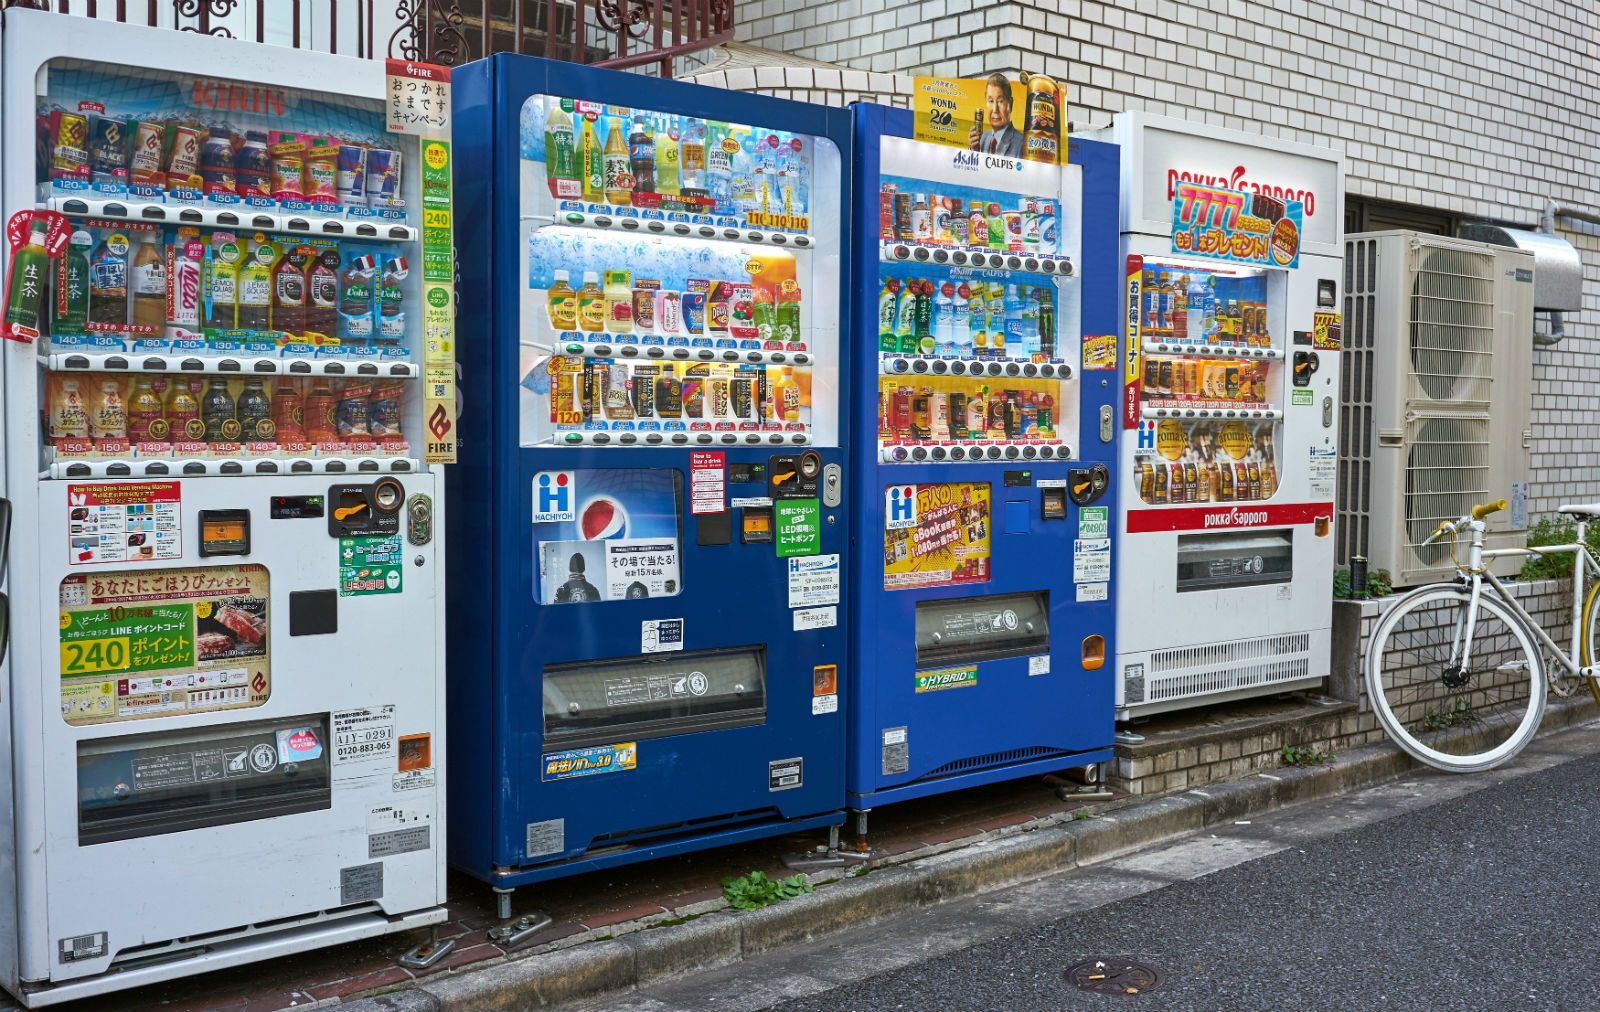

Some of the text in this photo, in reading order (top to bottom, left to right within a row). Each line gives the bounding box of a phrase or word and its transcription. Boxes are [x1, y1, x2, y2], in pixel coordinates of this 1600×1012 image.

[414, 68, 432, 77] FIRE
[392, 78, 447, 97] おつかれ
[193, 80, 285, 116] KIRIN
[392, 94, 446, 113] さまです
[930, 97, 957, 110] WONDA
[393, 110, 447, 127] キャンペーン
[710, 151, 729, 160] GREEN
[953, 151, 1014, 170] Asahi CALPIS
[1178, 185, 1245, 230] 7777
[427, 213, 448, 225] 240
[21, 264, 39, 298] 生茶
[67, 267, 82, 300] 生茶
[182, 264, 200, 310] Mets
[1129, 280, 1140, 376] お買得コーナー
[558, 411, 581, 424] 120
[428, 443, 453, 454] FIRE
[535, 513, 573, 521] HACHIYOH
[889, 520, 915, 528] HACHIYOH
[780, 533, 816, 544] ヒートポンプ
[611, 554, 676, 568] その場で当たる!
[92, 573, 251, 596] あなたにごほうびプレゼント
[111, 627, 132, 636] LINE
[134, 623, 187, 634] ポイントコード
[133, 636, 190, 653] ポイント
[66, 641, 124, 672] 240
[133, 652, 190, 666] をプレゼント!
[928, 671, 968, 686] HYBRID
[338, 729, 391, 744] A1Y-0291
[337, 742, 391, 756] 0120-883-065
